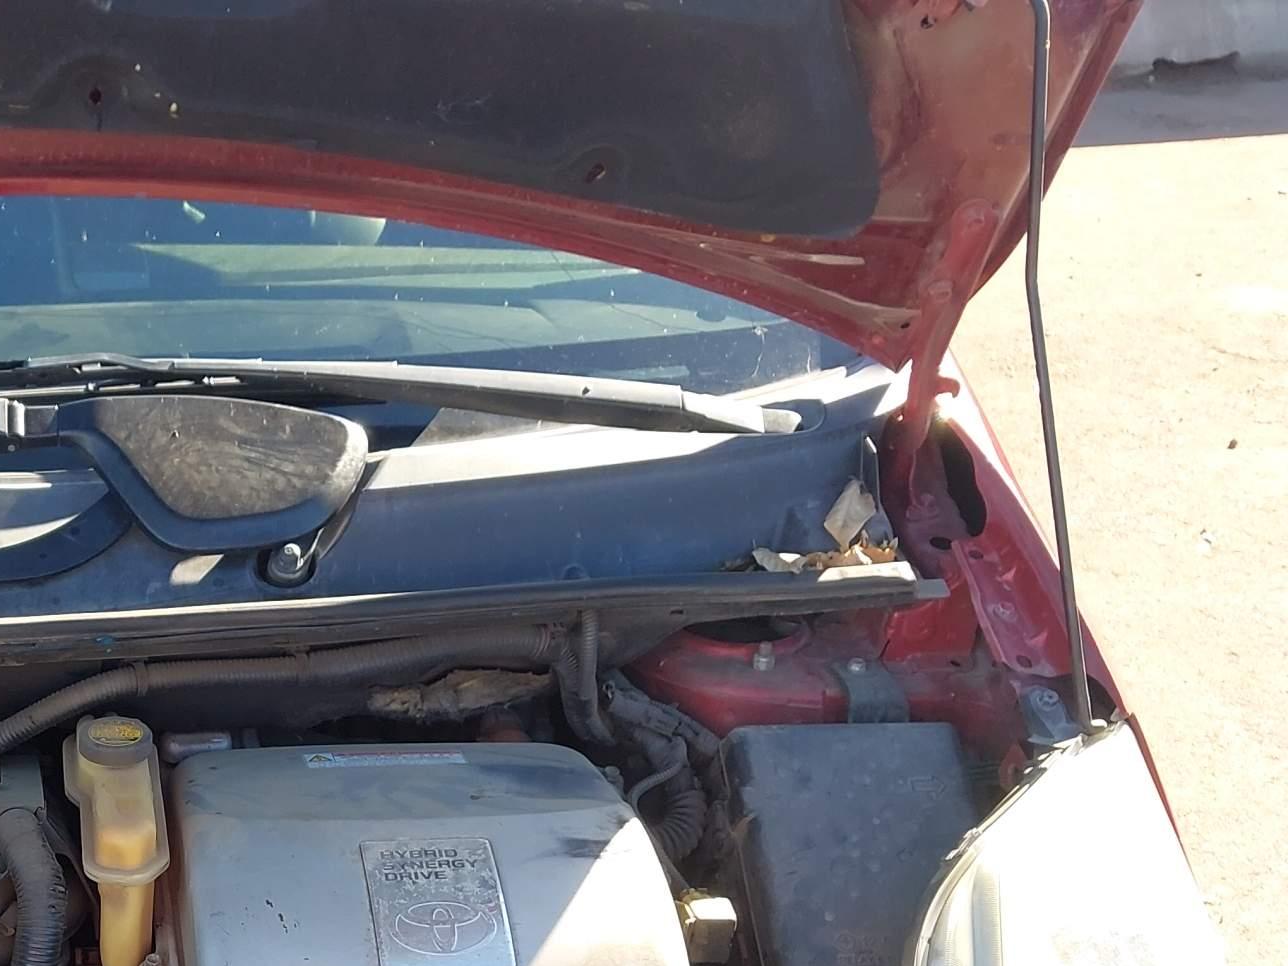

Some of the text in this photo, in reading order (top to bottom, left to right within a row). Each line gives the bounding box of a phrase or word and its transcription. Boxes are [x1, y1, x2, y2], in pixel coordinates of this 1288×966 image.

[380, 849, 458, 859] HYBRID
[383, 859, 478, 871] SYNERGY
[384, 871, 448, 882] DRIVE
